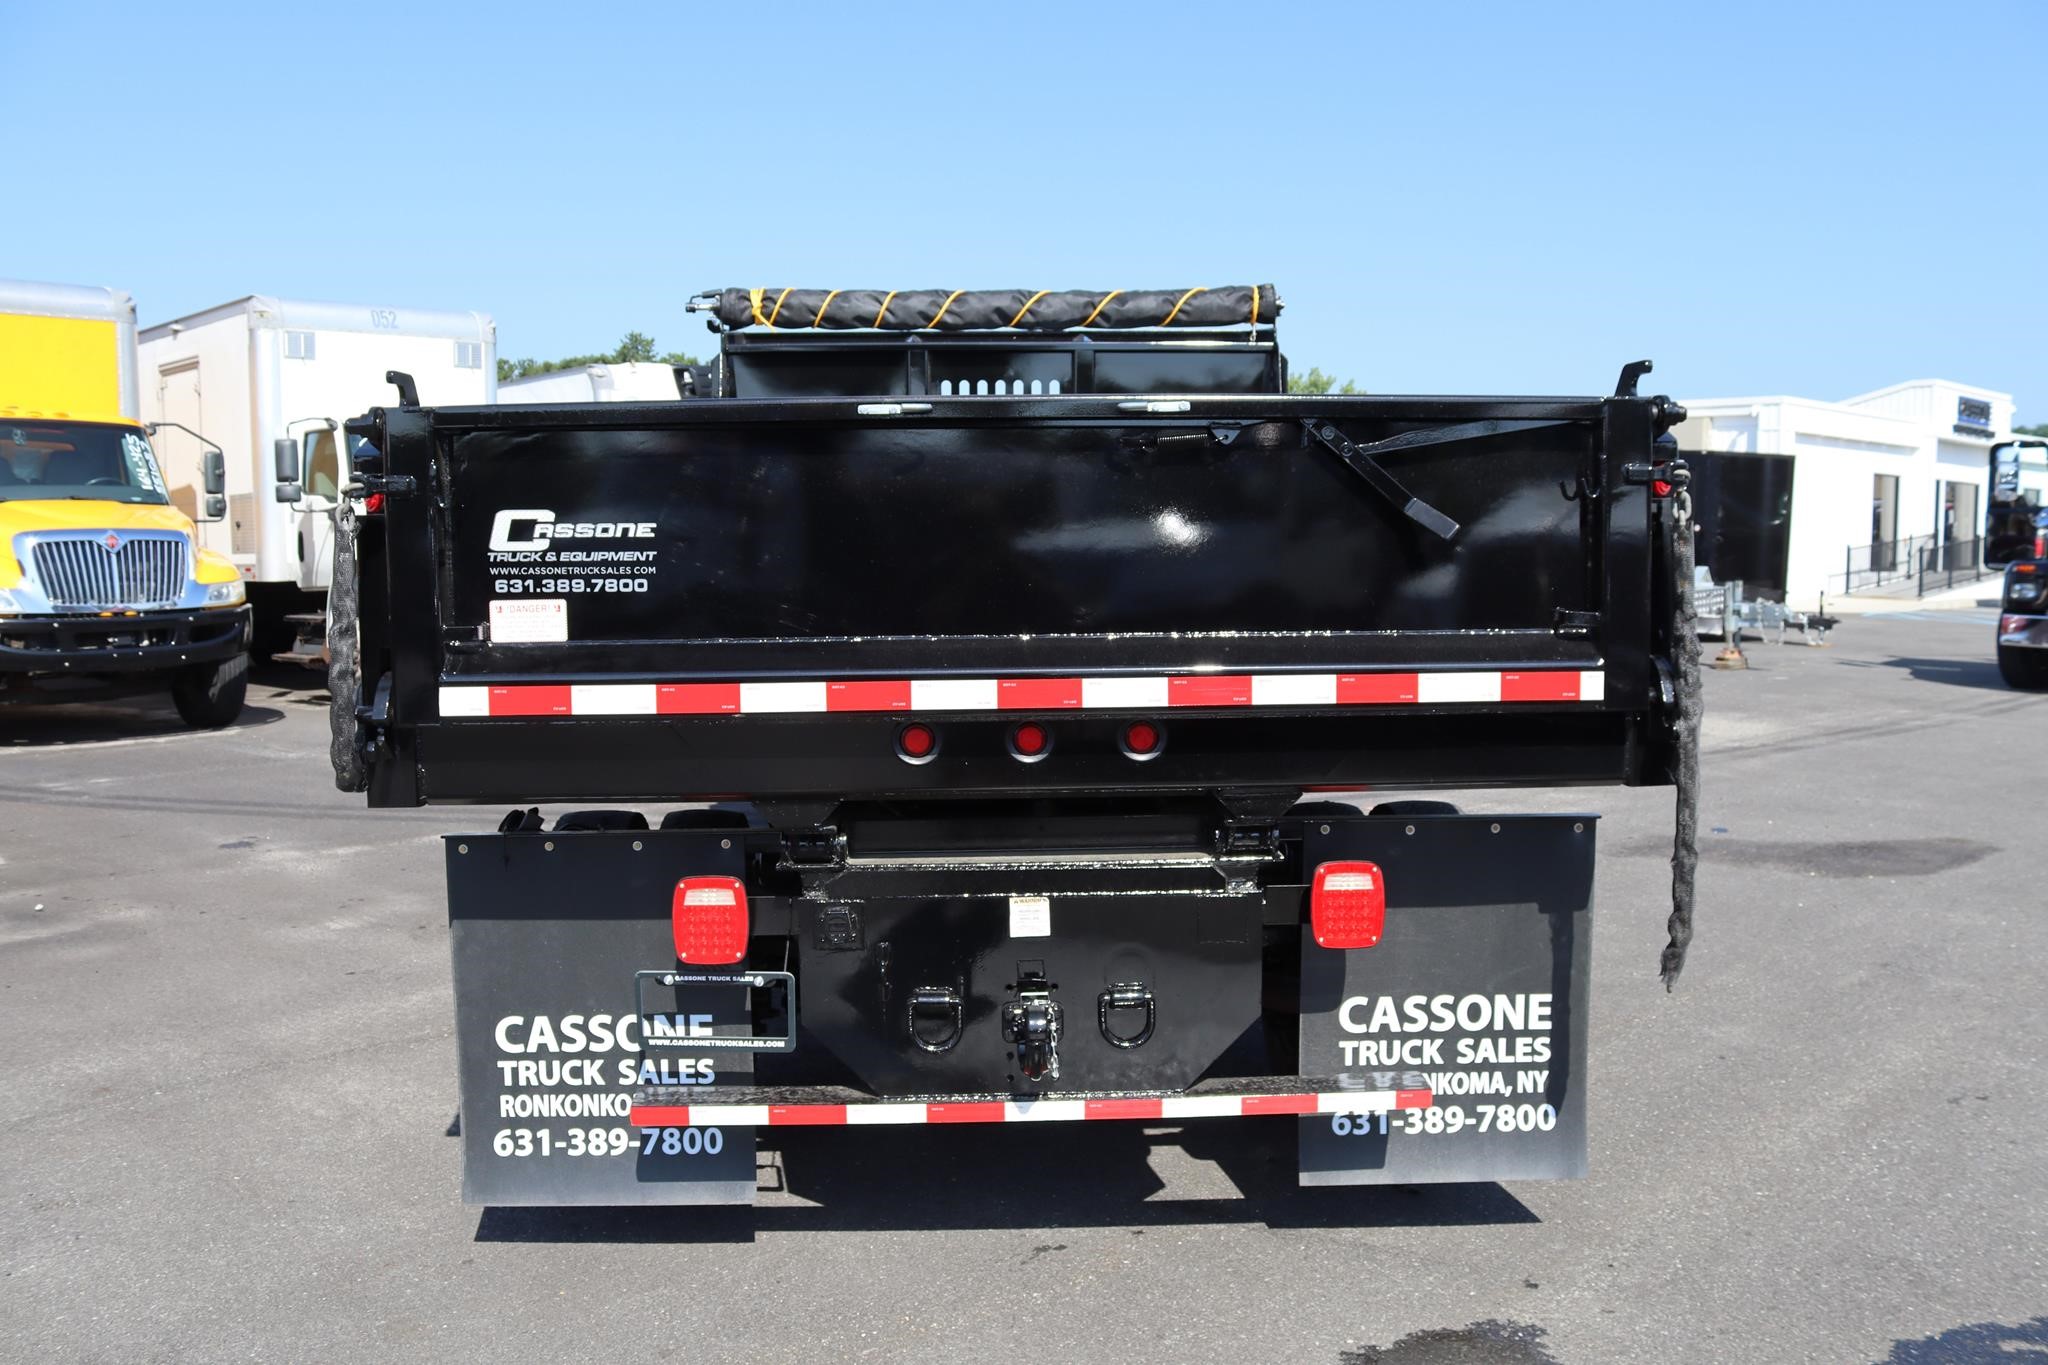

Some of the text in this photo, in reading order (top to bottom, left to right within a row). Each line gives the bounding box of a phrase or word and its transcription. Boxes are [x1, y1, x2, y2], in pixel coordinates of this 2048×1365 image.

[371, 310, 399, 328] 052
[488, 551, 657, 562] TRUCK & EQUIPMENT
[494, 578, 648, 593] 631.389.7800
[1338, 993, 1553, 1034] CASSONE
[1338, 1036, 1552, 1067] TRUCK SALES
[497, 1057, 716, 1087] TRUCK SALES
[1516, 1070, 1550, 1094] NY
[1331, 1103, 1557, 1136] 631-389-7800
[492, 1127, 723, 1157] 631-389-7800
